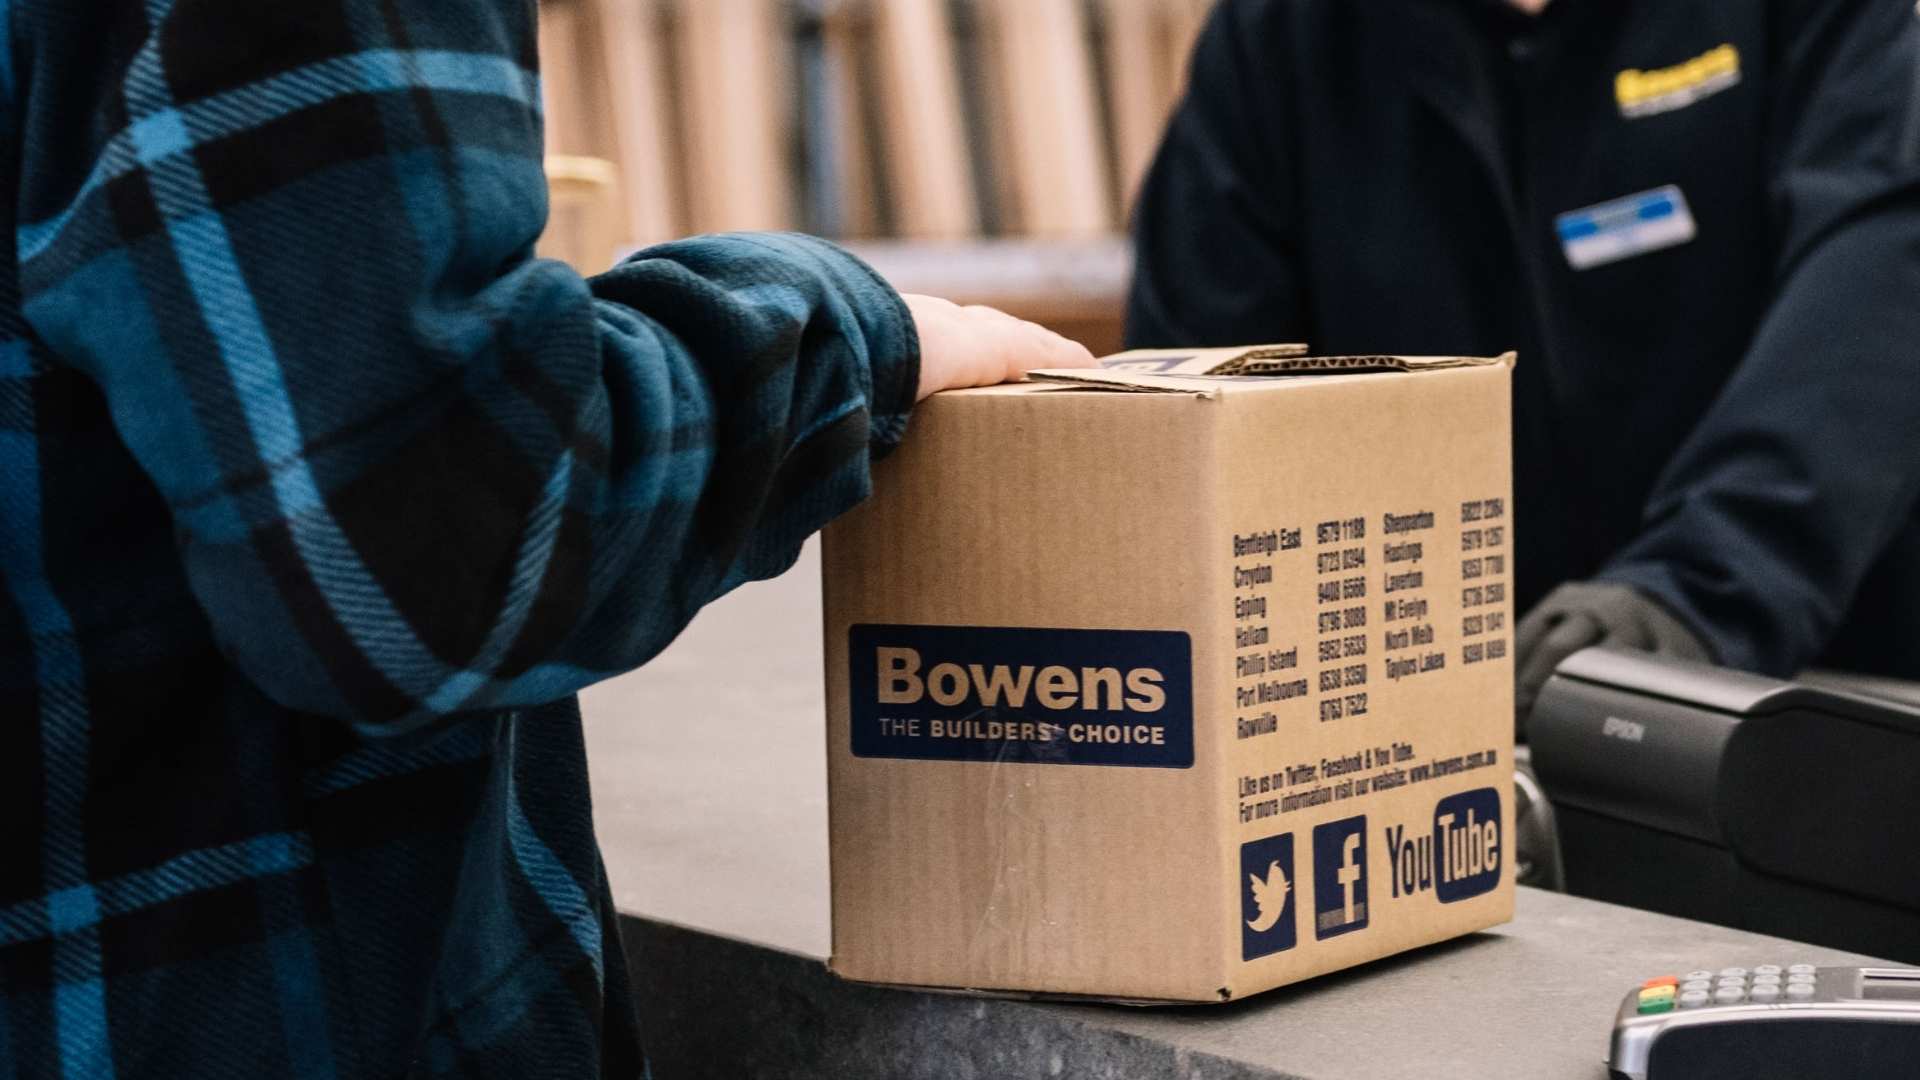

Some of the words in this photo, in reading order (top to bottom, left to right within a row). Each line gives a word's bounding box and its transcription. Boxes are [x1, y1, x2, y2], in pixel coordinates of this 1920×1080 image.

[1280, 528, 1301, 550] East
[1235, 564, 1272, 589] Croydon
[1235, 594, 1266, 620] Epping
[1268, 646, 1297, 671] Island
[1419, 651, 1445, 673] Lakes
[875, 646, 1167, 713] Bowens
[1236, 686, 1256, 708] Port
[1258, 679, 1308, 704] Melbourne
[879, 718, 920, 737] THE
[1068, 723, 1166, 745] CHOICE
[1239, 775, 1256, 798] Like
[1259, 774, 1270, 792] us
[1272, 772, 1282, 790] on
[1321, 754, 1362, 778] Facebook
[1240, 802, 1253, 824] For
[1256, 797, 1279, 818] more
[1281, 784, 1332, 812] information
[1355, 777, 1369, 797] our
